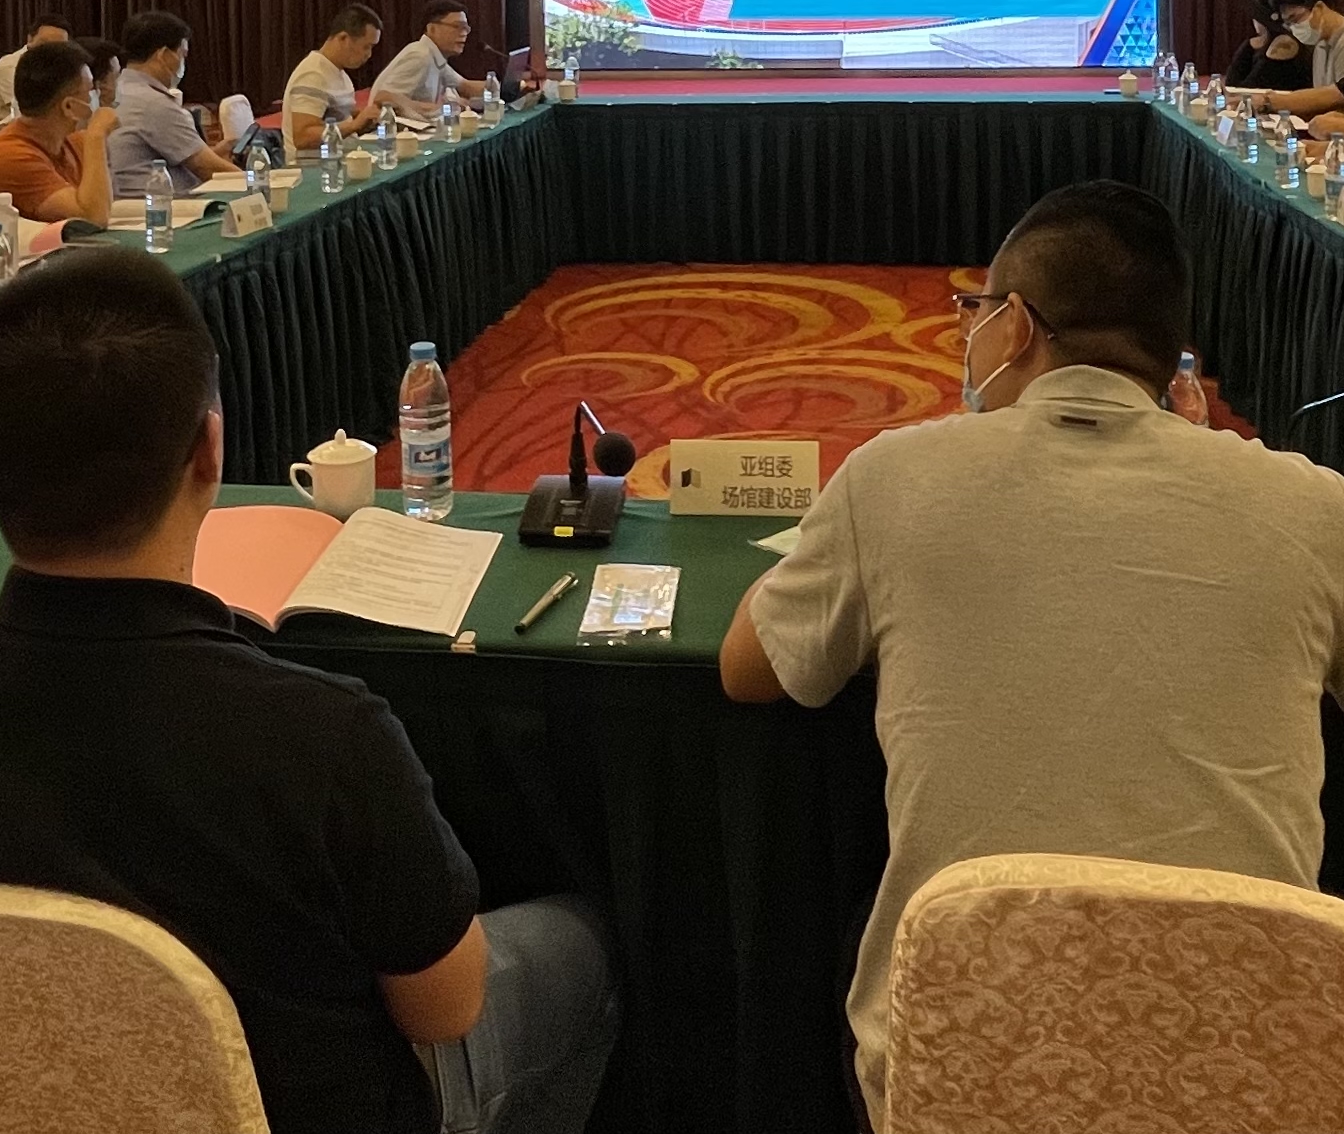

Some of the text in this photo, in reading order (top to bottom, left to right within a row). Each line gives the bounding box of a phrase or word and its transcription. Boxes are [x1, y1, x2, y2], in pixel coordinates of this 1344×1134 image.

[739, 455, 793, 478] 亚组委
[721, 485, 812, 509] 场馆建设部
